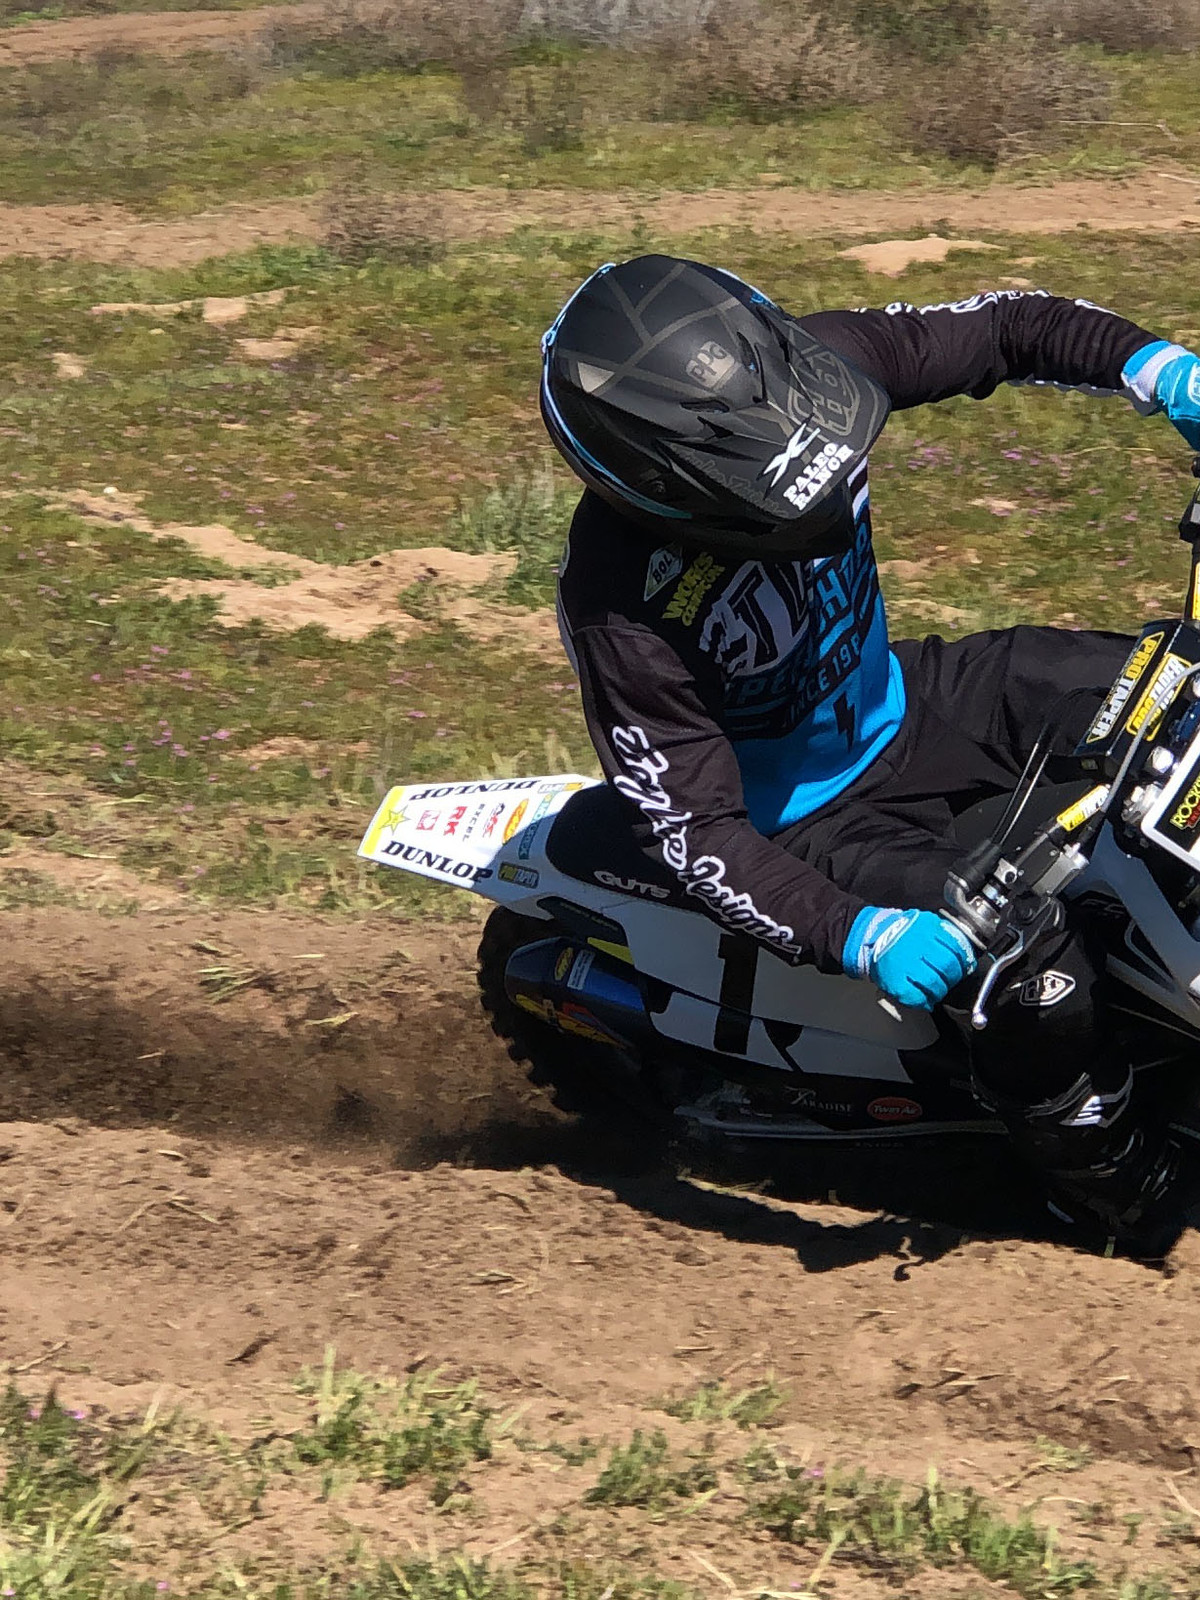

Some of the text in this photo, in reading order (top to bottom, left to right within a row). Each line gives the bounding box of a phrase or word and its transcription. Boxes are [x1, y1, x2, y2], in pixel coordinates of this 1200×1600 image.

[784, 442, 840, 506] PALEO
[794, 446, 854, 513] RANCH
[409, 779, 541, 801] DUNLOP
[443, 805, 467, 836] RK
[381, 840, 493, 884] DUNLOP
[593, 870, 671, 899] GUTS
[678, 855, 802, 955] Designs
